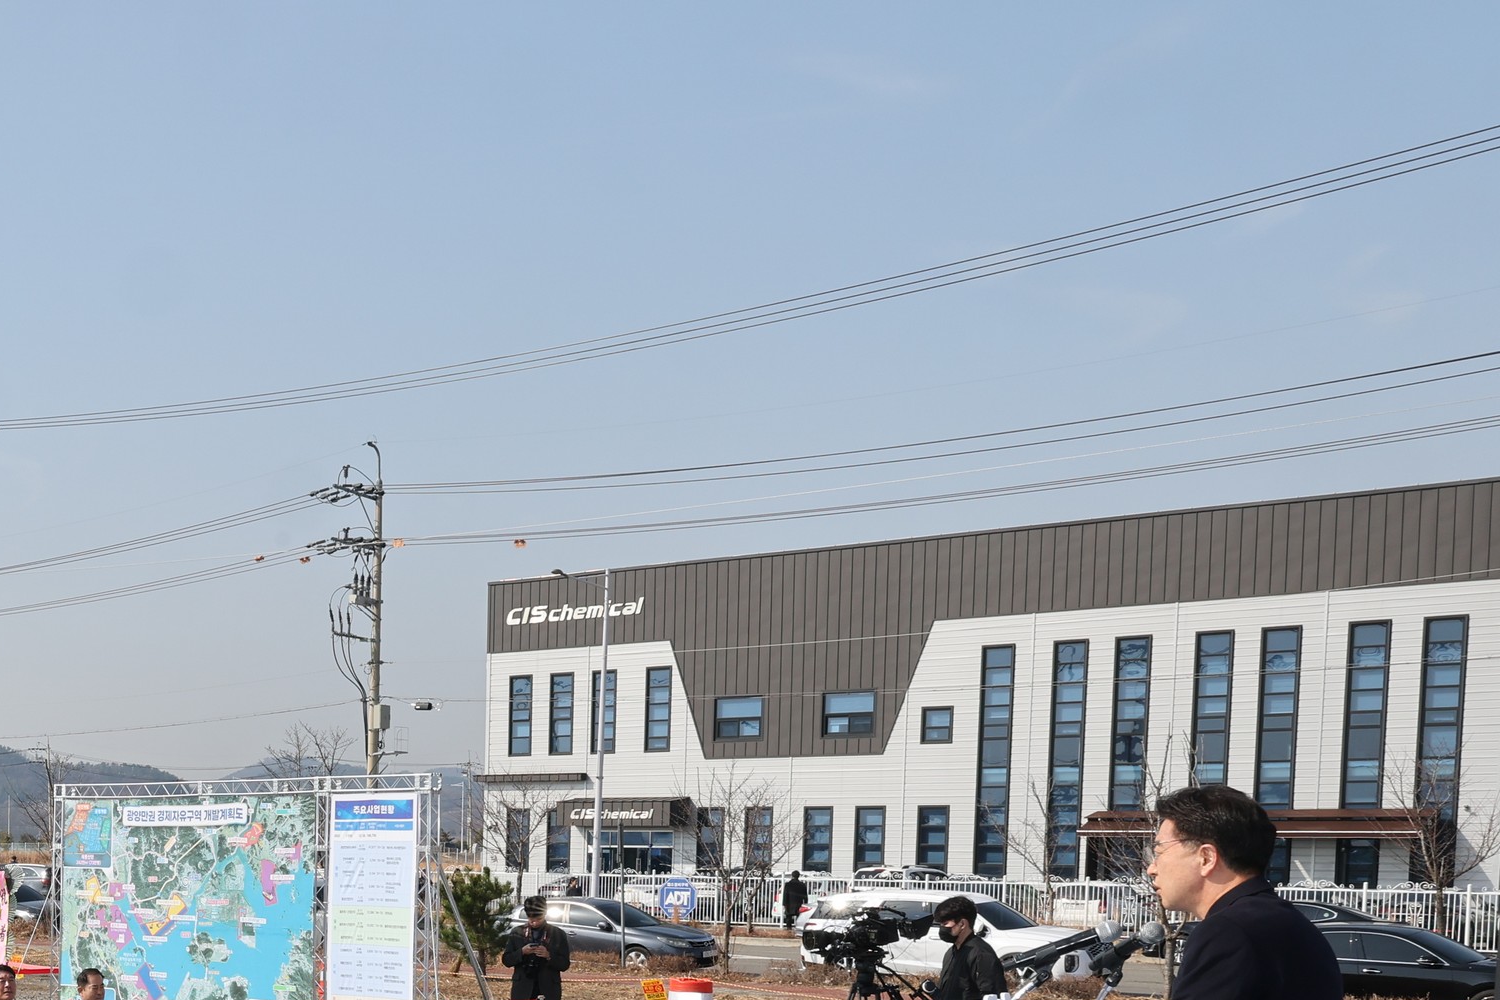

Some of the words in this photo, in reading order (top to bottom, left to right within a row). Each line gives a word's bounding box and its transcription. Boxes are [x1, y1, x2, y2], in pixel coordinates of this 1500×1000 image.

[127, 810, 156, 822] 광양만권
[157, 809, 202, 822] 경제자유구역
[204, 807, 244, 821] 개발계획도
[353, 804, 395, 815] 주요사업현황
[665, 890, 691, 906] ADT
